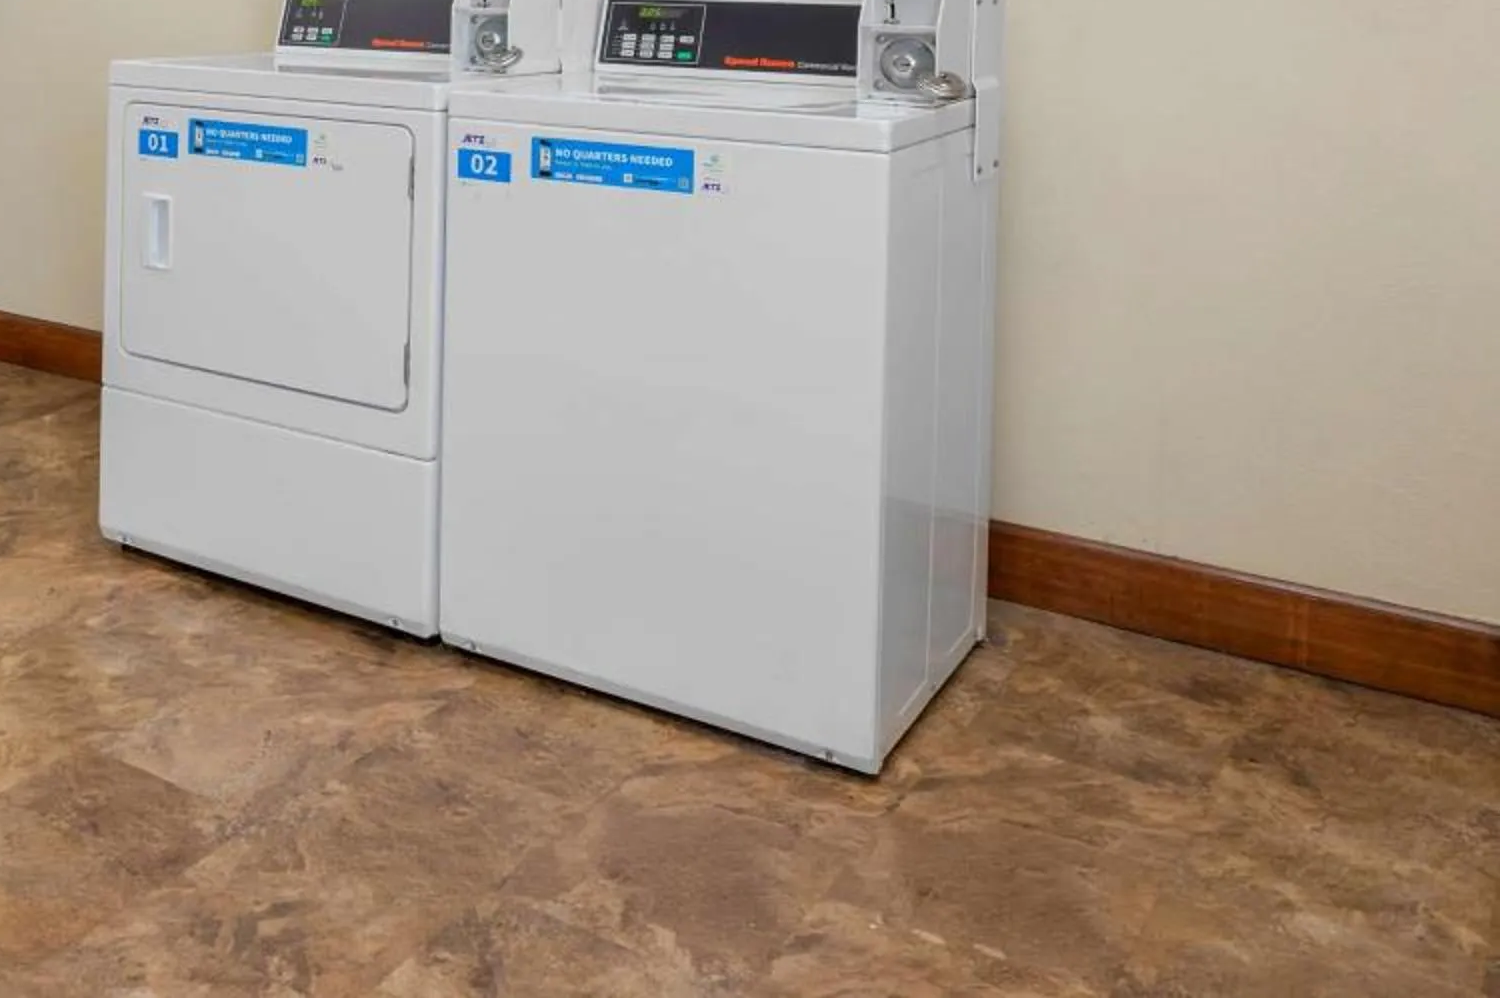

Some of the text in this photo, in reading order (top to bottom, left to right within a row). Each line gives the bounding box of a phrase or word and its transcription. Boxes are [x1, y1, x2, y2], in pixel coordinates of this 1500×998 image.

[147, 133, 169, 153] 01
[470, 153, 499, 175] 02
[555, 147, 674, 167] NO QUARTERS NEEDED
